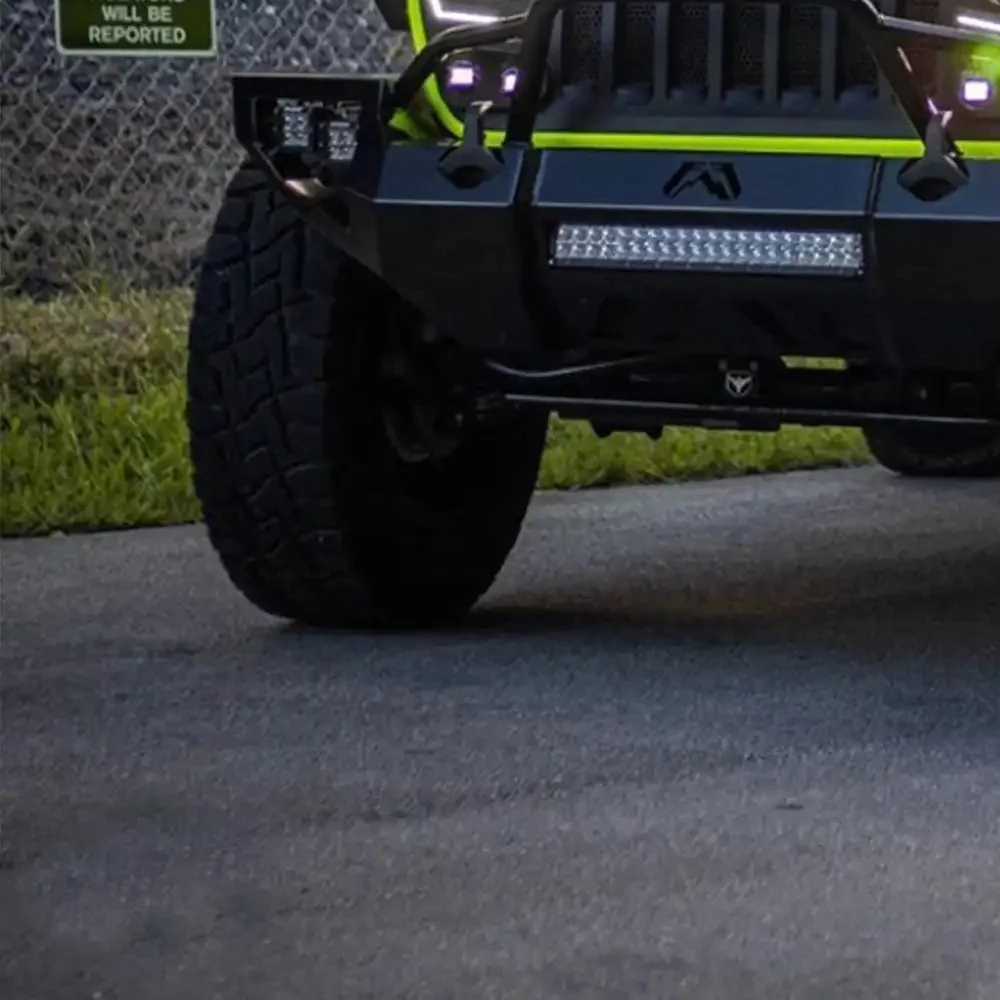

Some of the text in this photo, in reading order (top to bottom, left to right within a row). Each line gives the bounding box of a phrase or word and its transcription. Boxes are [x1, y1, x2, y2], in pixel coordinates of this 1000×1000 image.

[102, 5, 173, 23] WILL BE
[88, 26, 187, 44] REPORTED
